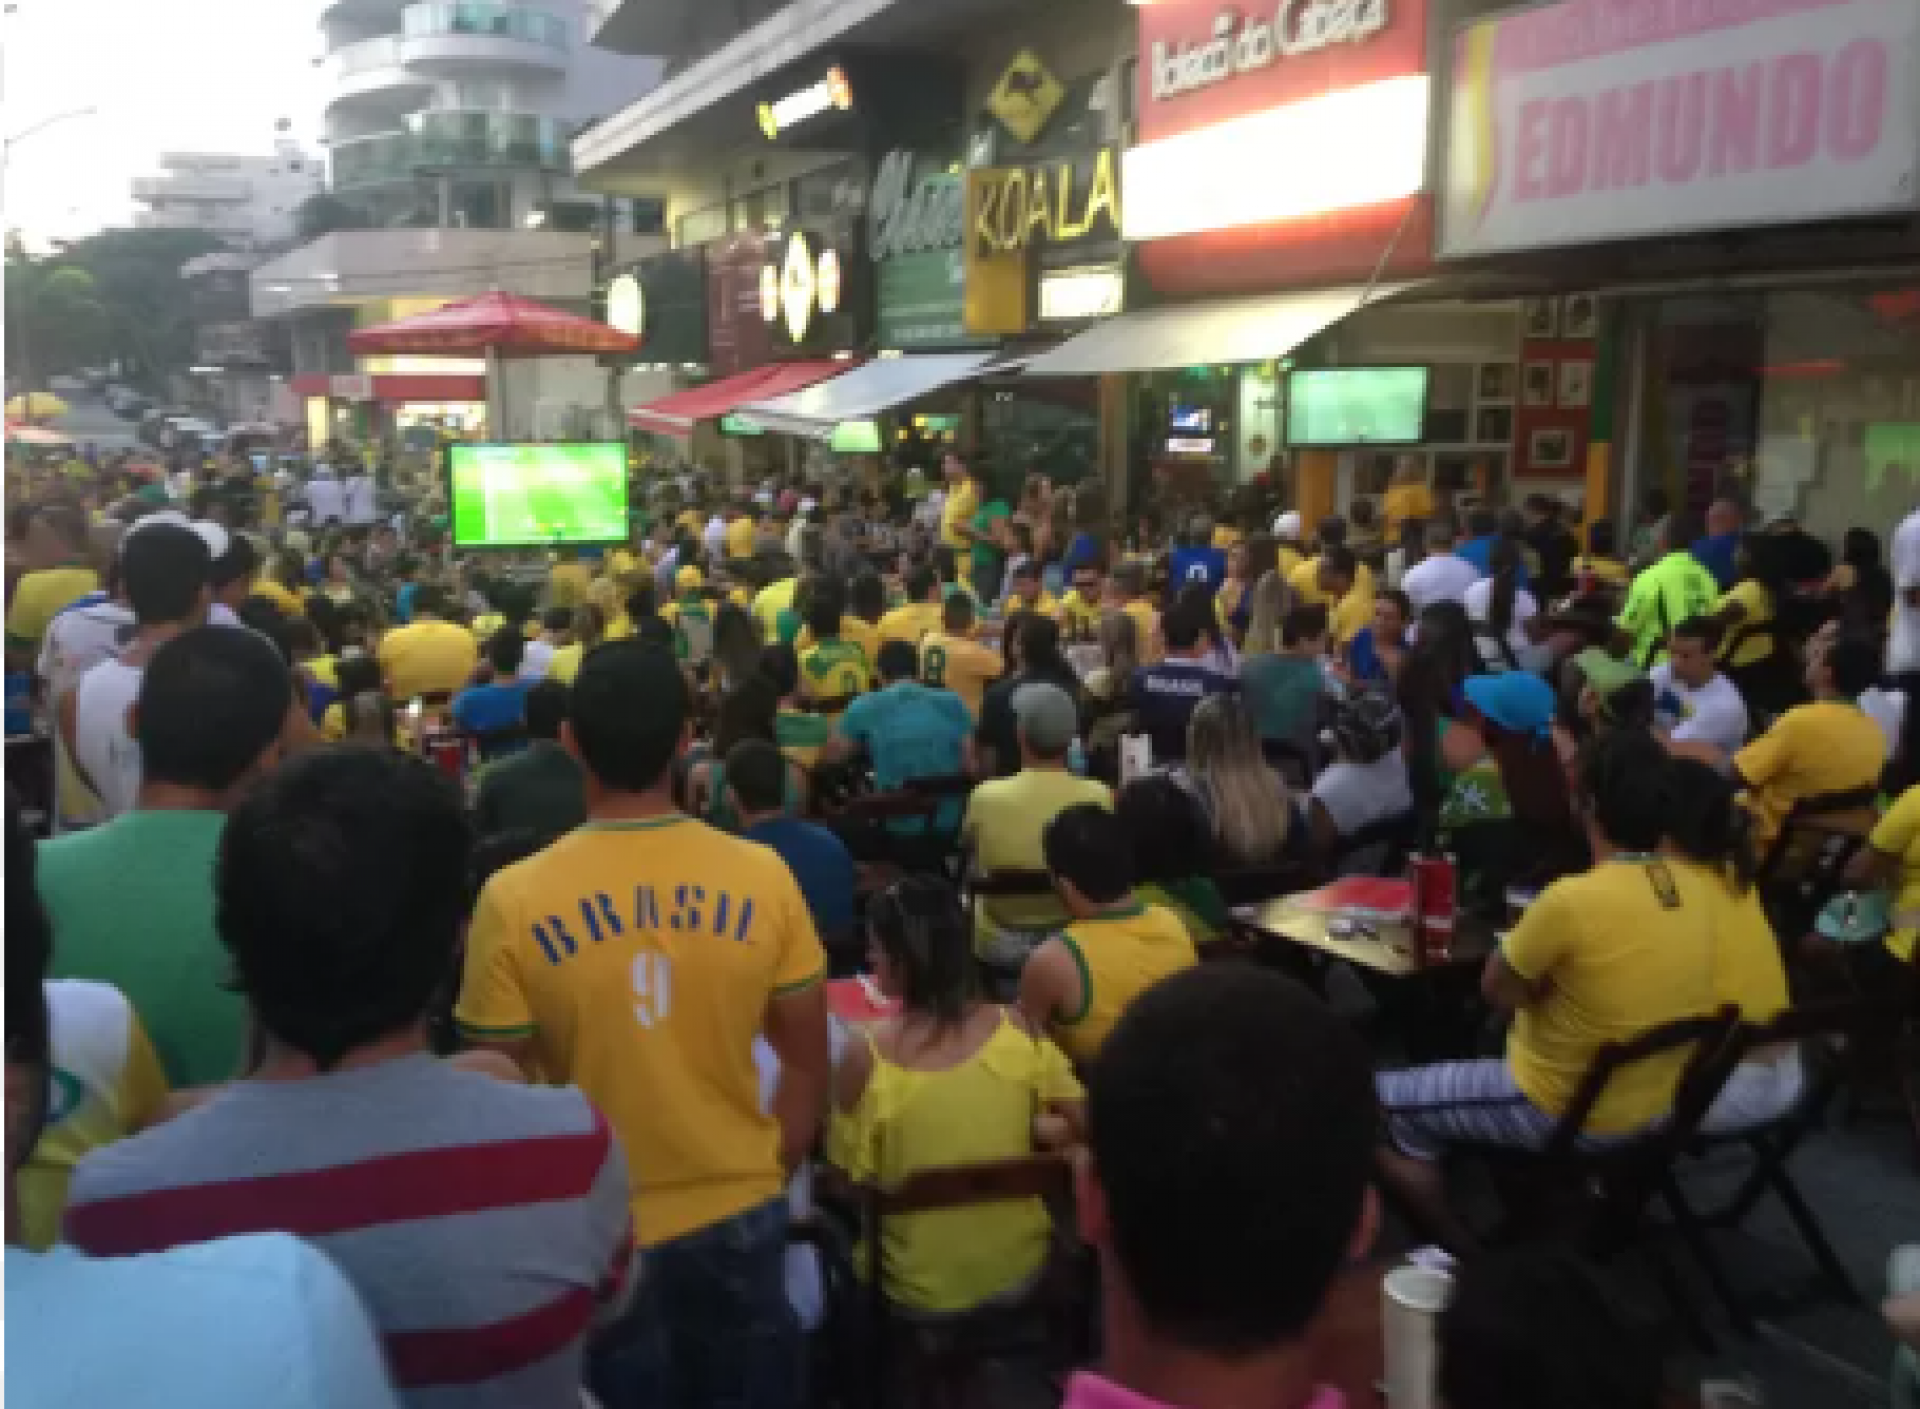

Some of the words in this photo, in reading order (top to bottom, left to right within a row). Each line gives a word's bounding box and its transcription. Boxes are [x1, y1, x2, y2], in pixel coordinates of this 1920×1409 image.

[1513, 38, 1889, 203] EDMUNDO
[974, 147, 1120, 251] KOALA
[531, 884, 756, 966] BRASIL
[630, 949, 672, 1030] 9
